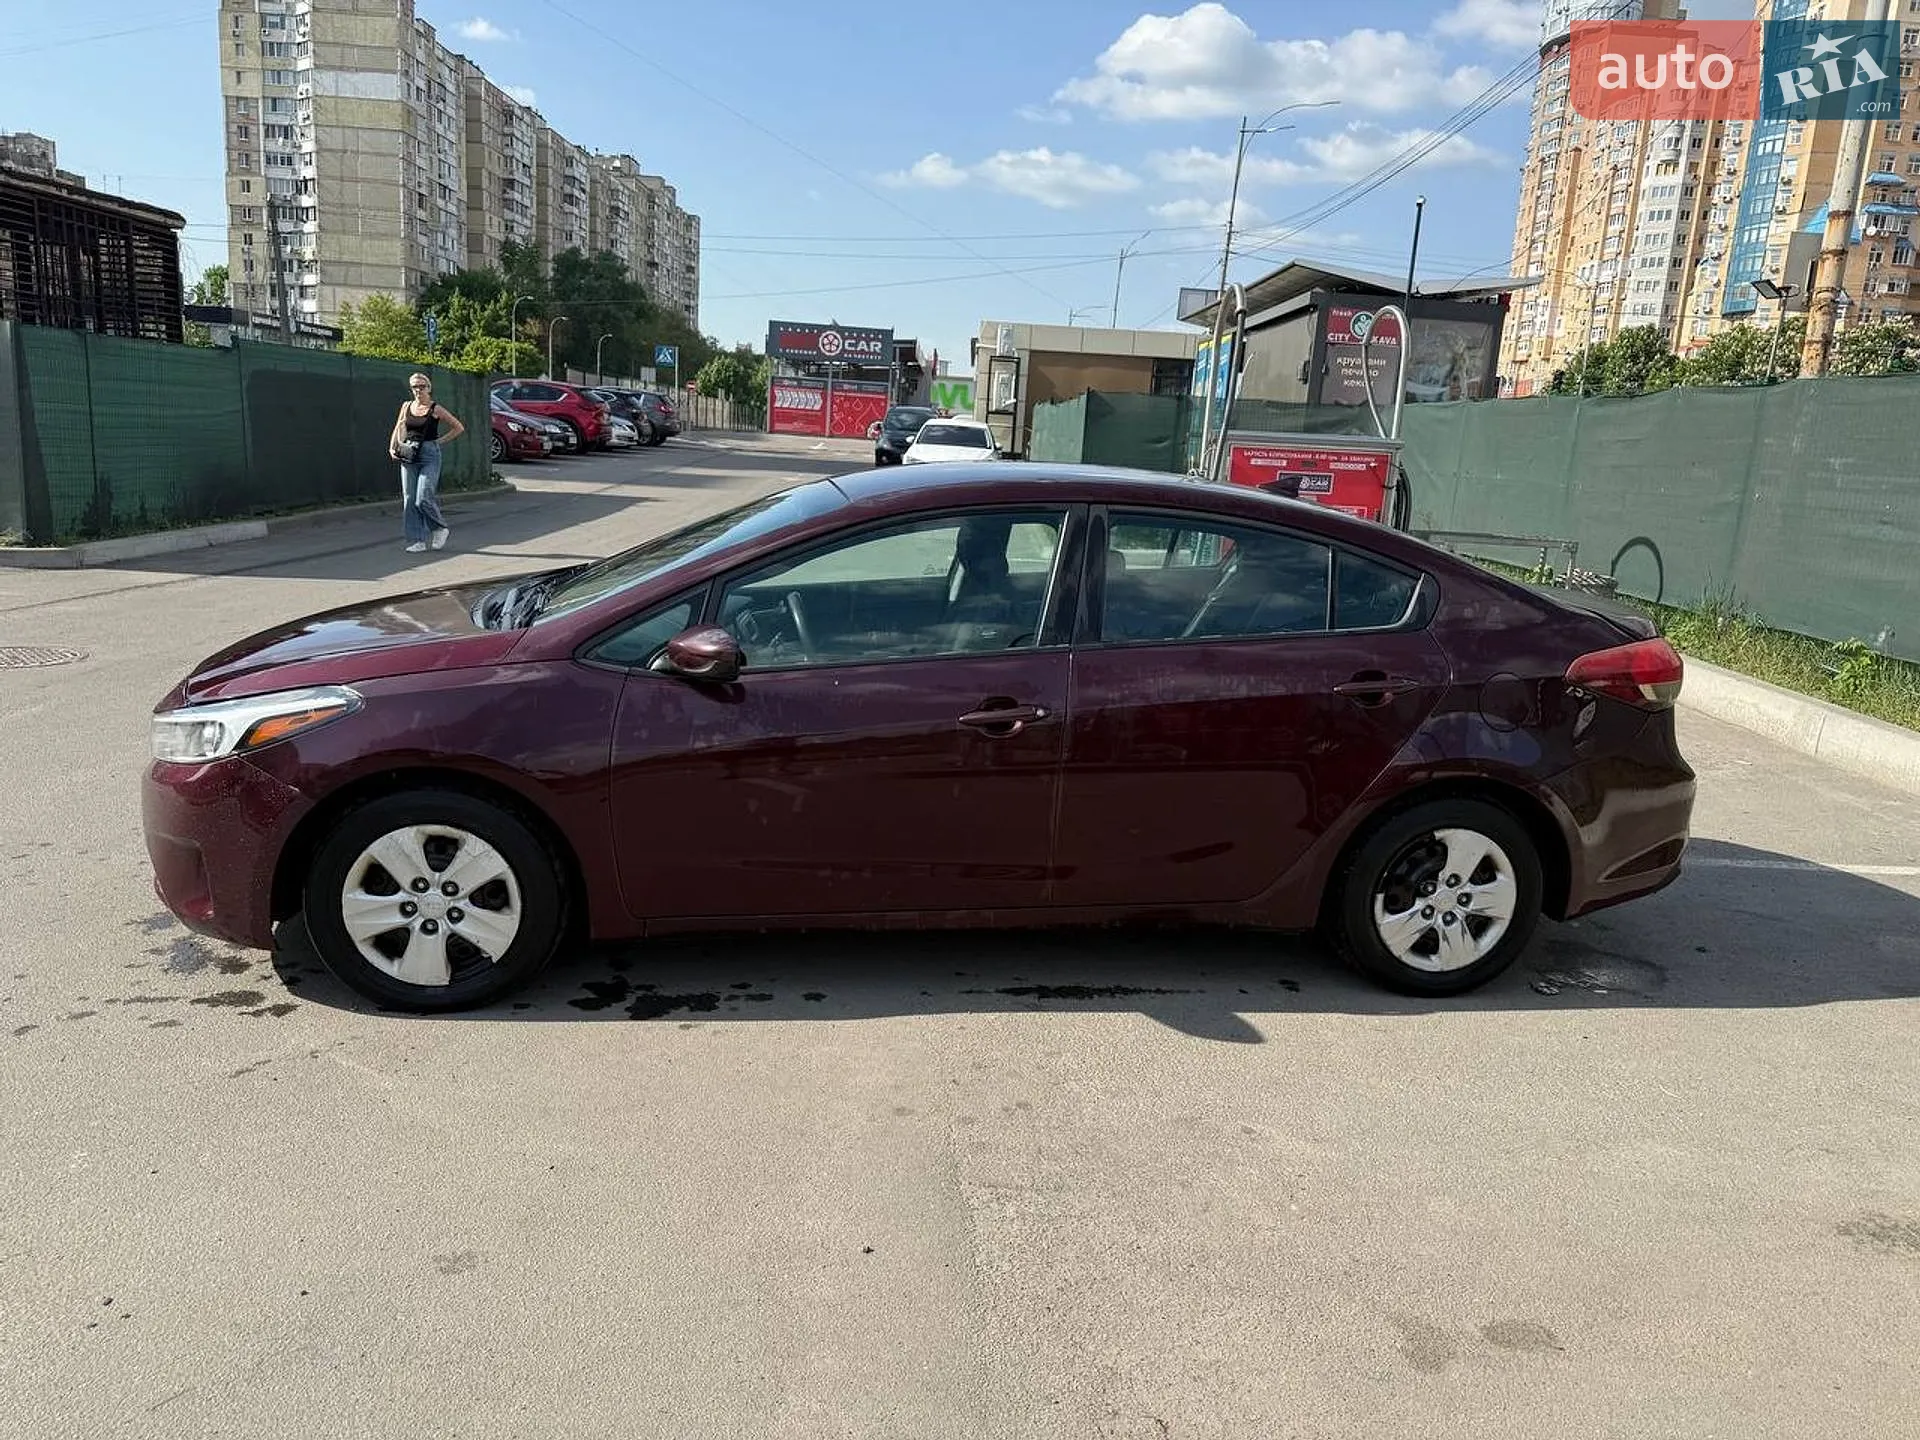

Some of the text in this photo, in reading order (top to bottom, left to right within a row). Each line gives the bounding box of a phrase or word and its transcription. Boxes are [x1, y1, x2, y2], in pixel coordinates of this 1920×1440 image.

[1327, 332, 1350, 342] CITY
[843, 338, 882, 354] CAR
[1336, 356, 1387, 368] круаани
